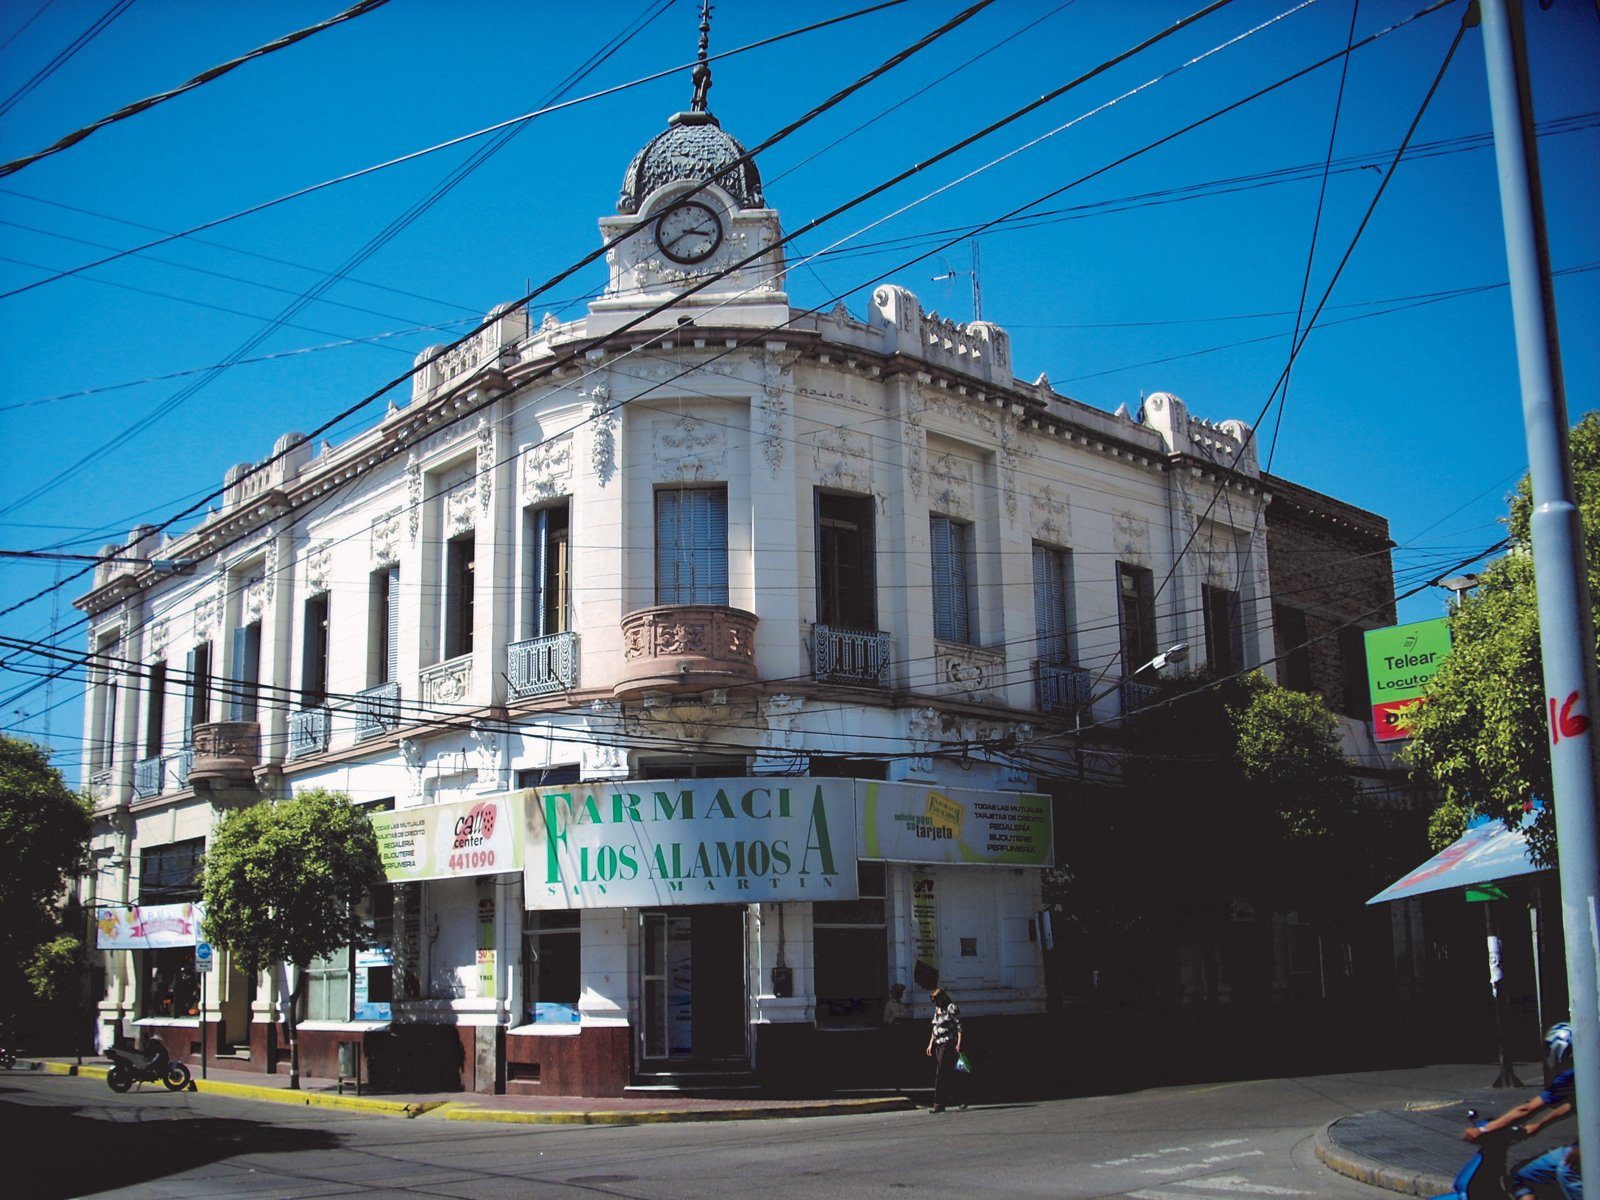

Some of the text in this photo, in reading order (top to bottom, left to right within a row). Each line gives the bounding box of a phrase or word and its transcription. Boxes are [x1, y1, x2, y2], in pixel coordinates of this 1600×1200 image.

[1384, 652, 1437, 670] Telear
[1549, 690, 1590, 744] 16
[974, 802, 996, 811] TODAS
[1010, 806, 1043, 814] MUTUALES
[974, 812, 1007, 820] TARJETAS
[454, 811, 484, 837] call
[916, 824, 953, 841] tarjeta
[453, 835, 484, 849] center
[542, 784, 839, 885] FARMACIA
[989, 833, 1032, 843] BIJOUTERIE
[448, 849, 495, 870] 441090
[580, 839, 792, 882] LOS ALAMOS
[547, 877, 833, 896] SAN MARTIN
